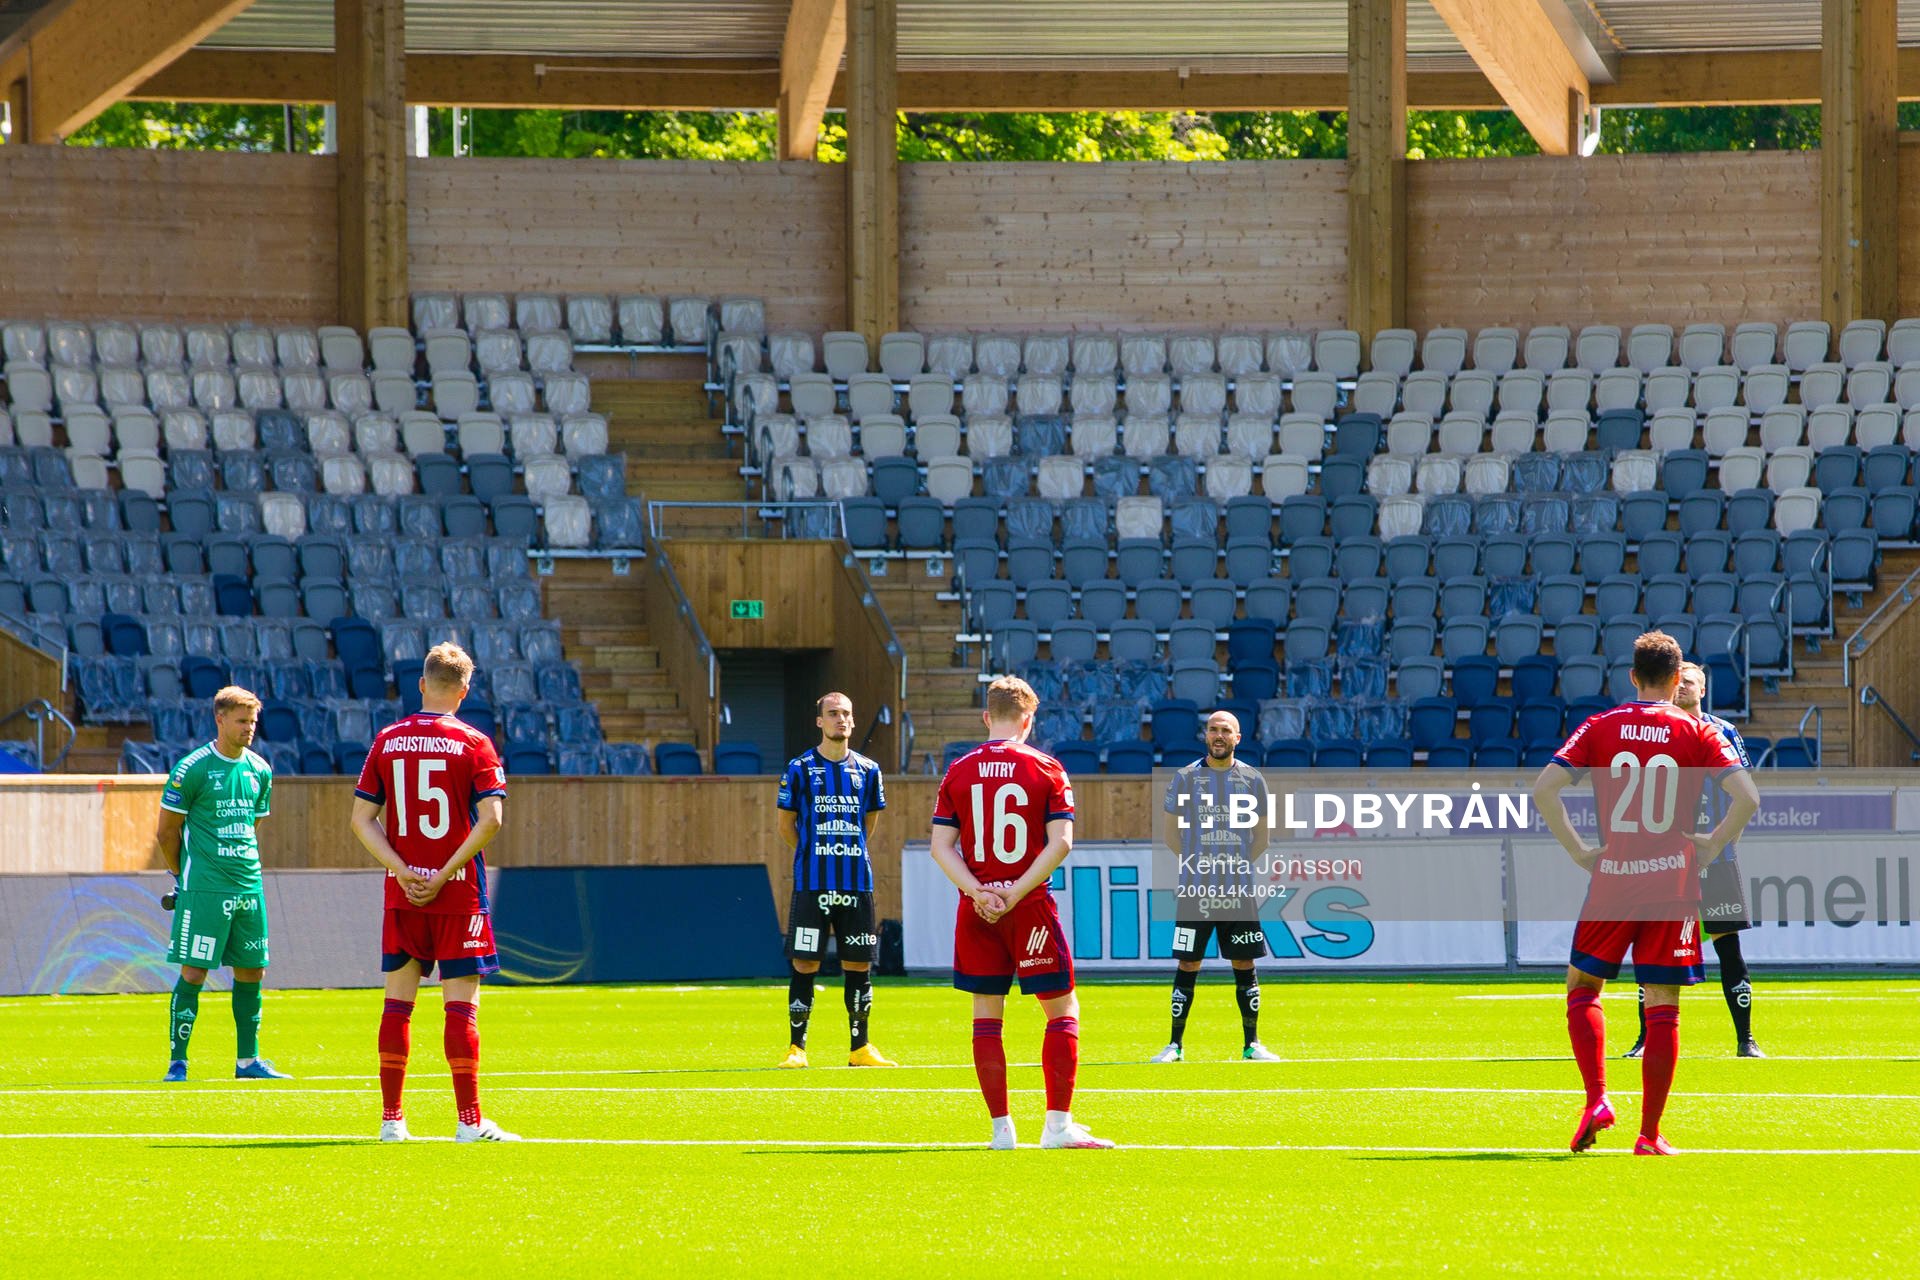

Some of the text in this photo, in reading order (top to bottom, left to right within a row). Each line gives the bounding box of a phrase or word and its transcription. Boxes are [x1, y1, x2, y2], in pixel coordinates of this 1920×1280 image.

[1620, 724, 1671, 744] KUJOVIĆ
[382, 736, 465, 756] AUGUSTINSSON
[978, 761, 1016, 778] WITRY
[392, 758, 450, 840] 15
[815, 795, 837, 804] BYGG
[1610, 751, 1680, 834] 20
[216, 799, 237, 809] BYGG
[815, 804, 860, 814] CONSTRUCT
[1198, 805, 1221, 813] BYGG
[971, 783, 1029, 865] 16
[1527, 808, 1598, 832] Upala
[815, 842, 863, 857] inkClub
[1600, 853, 1686, 875] ERLANDSSON
[1750, 857, 1920, 929] mell
[222, 895, 258, 920] gibon
